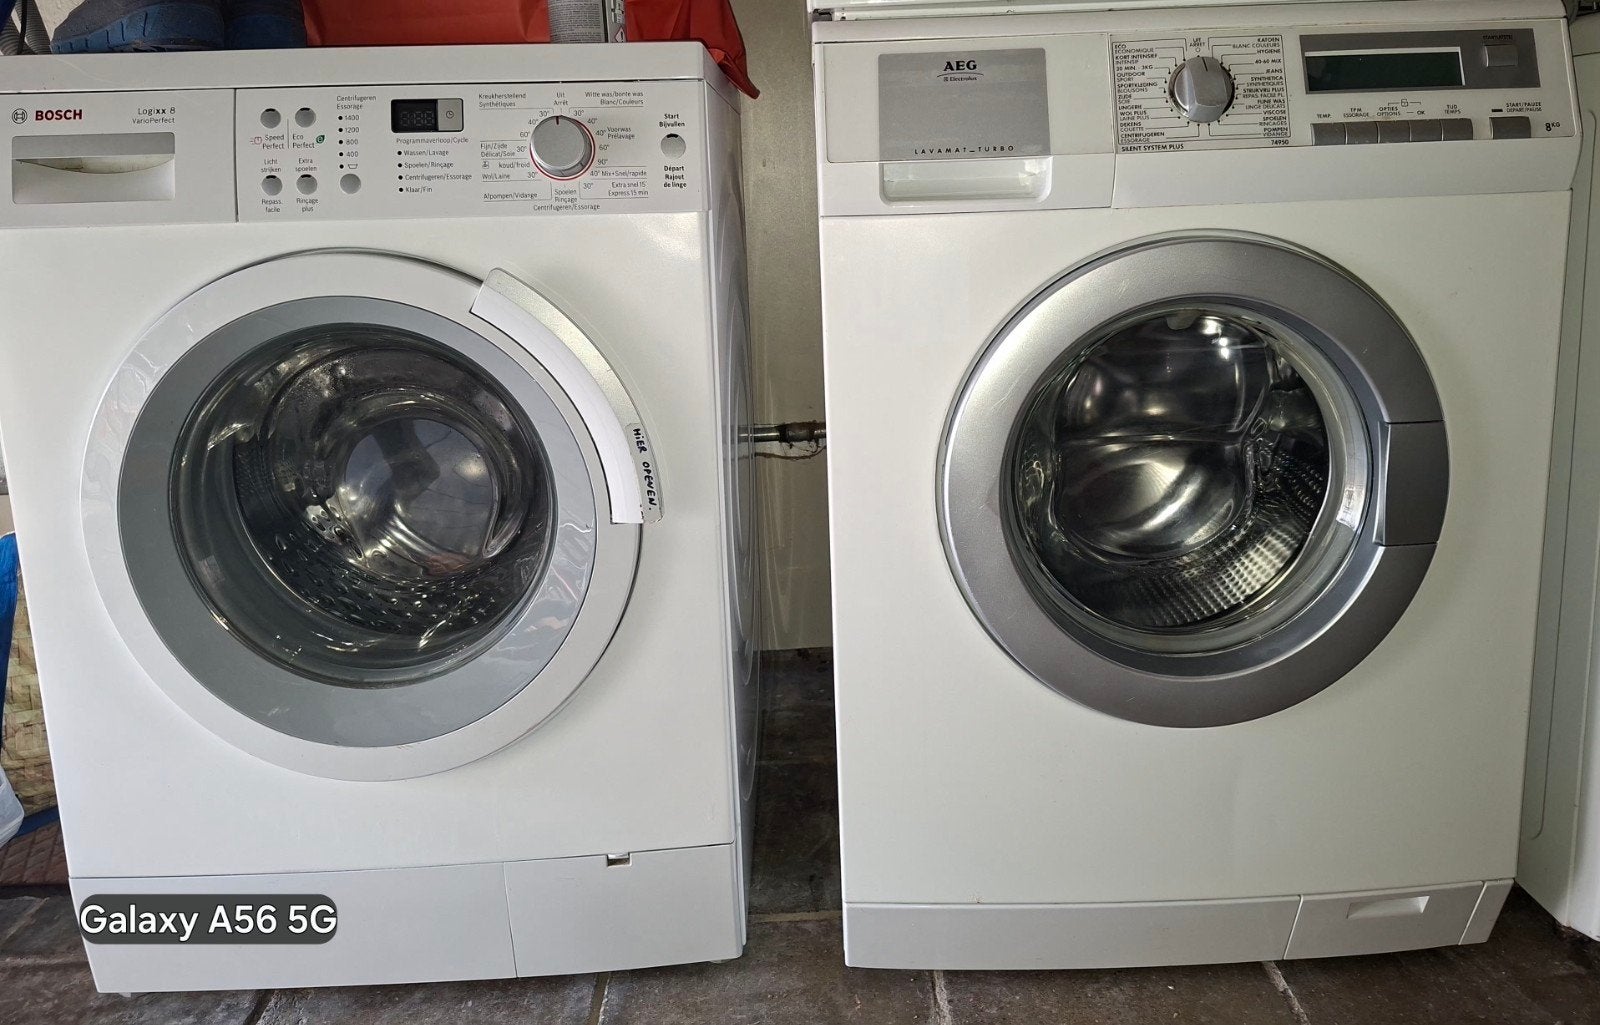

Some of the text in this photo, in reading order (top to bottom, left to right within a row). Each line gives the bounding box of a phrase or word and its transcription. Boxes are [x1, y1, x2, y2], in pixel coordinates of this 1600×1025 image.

[943, 60, 978, 72] AEG
[600, 98, 644, 106] Blanc/Couleurs
[35, 109, 83, 121] BOSCH
[137, 106, 176, 117] Logixx 8
[573, 109, 585, 117] 30°
[396, 137, 469, 145] Programmaverloop/Cycle
[262, 142, 285, 150] Perfect
[403, 149, 449, 157] Wassen/Lavage
[480, 150, 516, 158] Délicat/Soie
[404, 161, 454, 169] Spoelen/Rinçage
[663, 165, 685, 173] Départ
[405, 173, 473, 181] Centrifugeren/Essorage
[601, 170, 647, 178] Mix+Snel/rapide
[664, 173, 685, 181] Rajout
[672, 181, 687, 189] linge
[483, 192, 538, 200] Afpompen/Vidange
[554, 196, 578, 204] Rinçage
[533, 202, 601, 211] Centrifugeren/Essorage
